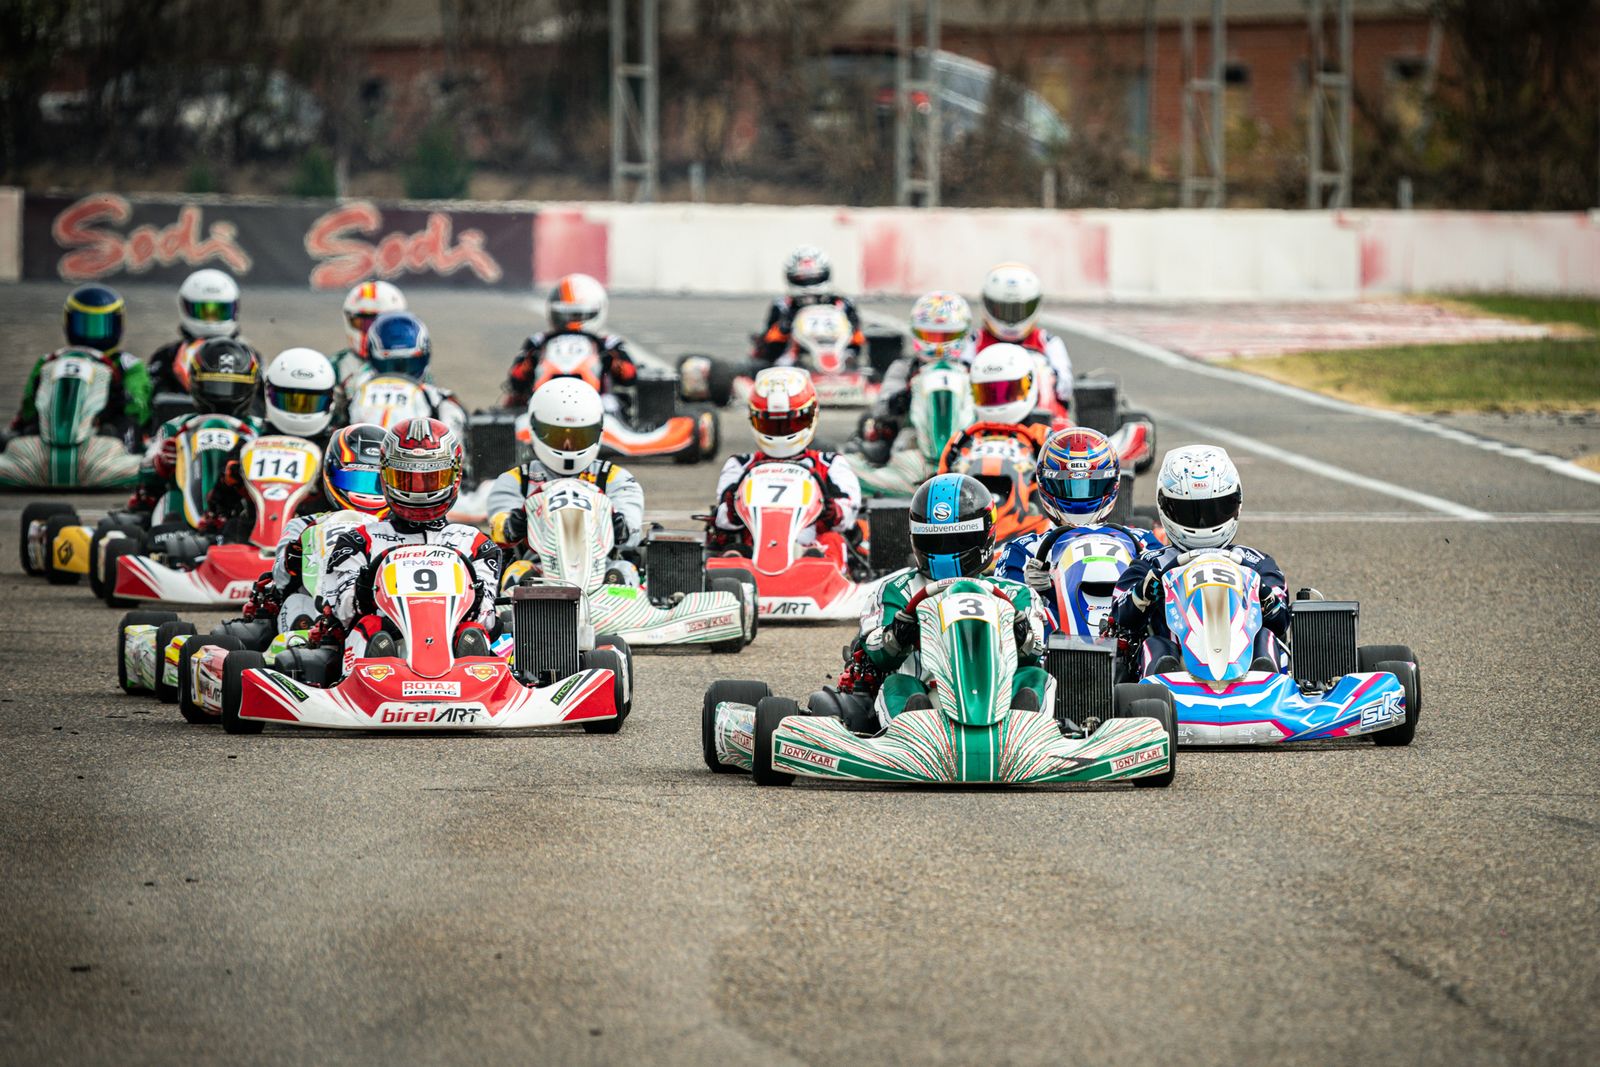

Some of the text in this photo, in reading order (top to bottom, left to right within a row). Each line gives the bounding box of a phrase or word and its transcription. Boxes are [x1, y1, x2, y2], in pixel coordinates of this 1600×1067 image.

[52, 193, 252, 281] Sodi
[304, 200, 503, 290] Sodi
[200, 432, 231, 446] 35
[255, 458, 299, 479] 114
[1071, 460, 1088, 469] BELL
[548, 490, 592, 512] 55
[767, 485, 787, 503] 7
[913, 522, 980, 533] eurosubvenciones
[393, 549, 455, 561] birelART
[1075, 542, 1121, 557] 17
[413, 568, 438, 592] 9
[1191, 568, 1237, 588] 15
[958, 598, 985, 617] 3
[403, 683, 456, 691] ROTAX
[382, 707, 481, 724] birelART
[1362, 694, 1404, 726] SLK
